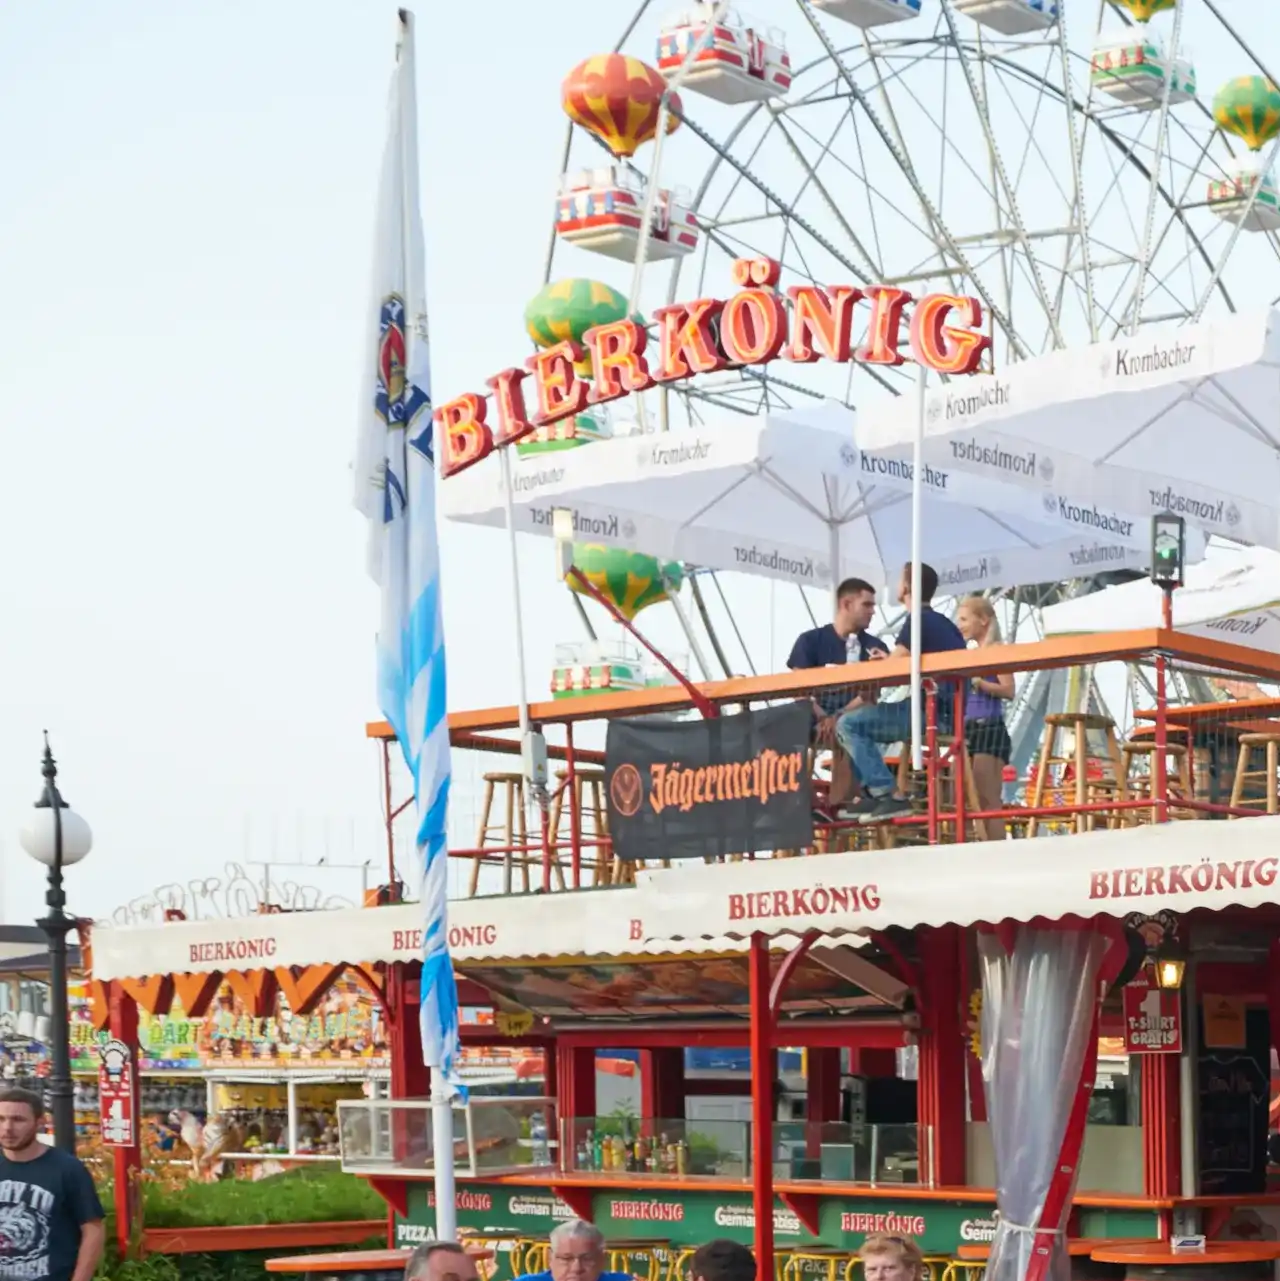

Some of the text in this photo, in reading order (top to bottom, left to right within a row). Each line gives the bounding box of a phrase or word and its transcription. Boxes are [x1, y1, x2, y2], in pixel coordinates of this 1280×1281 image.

[433, 256, 994, 480] BIERKÖNIG
[1114, 345, 1196, 376] Krombacher
[945, 380, 1010, 419] Krombche
[1057, 494, 1135, 538] Krombacher
[1088, 857, 1280, 900] BIERKÖNIG
[728, 884, 882, 921] BIERKÖNIG
[188, 936, 277, 964] BIERKÖNIG
[392, 923, 498, 951] BIEÖNIG
[1129, 1015, 1176, 1030] T-SHIRT
[1130, 1030, 1177, 1045] GRATIS
[427, 1187, 492, 1212] BKÖNIG
[508, 1196, 550, 1216] German
[611, 1199, 684, 1222] BIERKÖNIG
[714, 1206, 757, 1227] Germa
[841, 1210, 926, 1236] BIERKÖNIG
[397, 1224, 435, 1243] PIZZA
[960, 1219, 998, 1242] Germ
